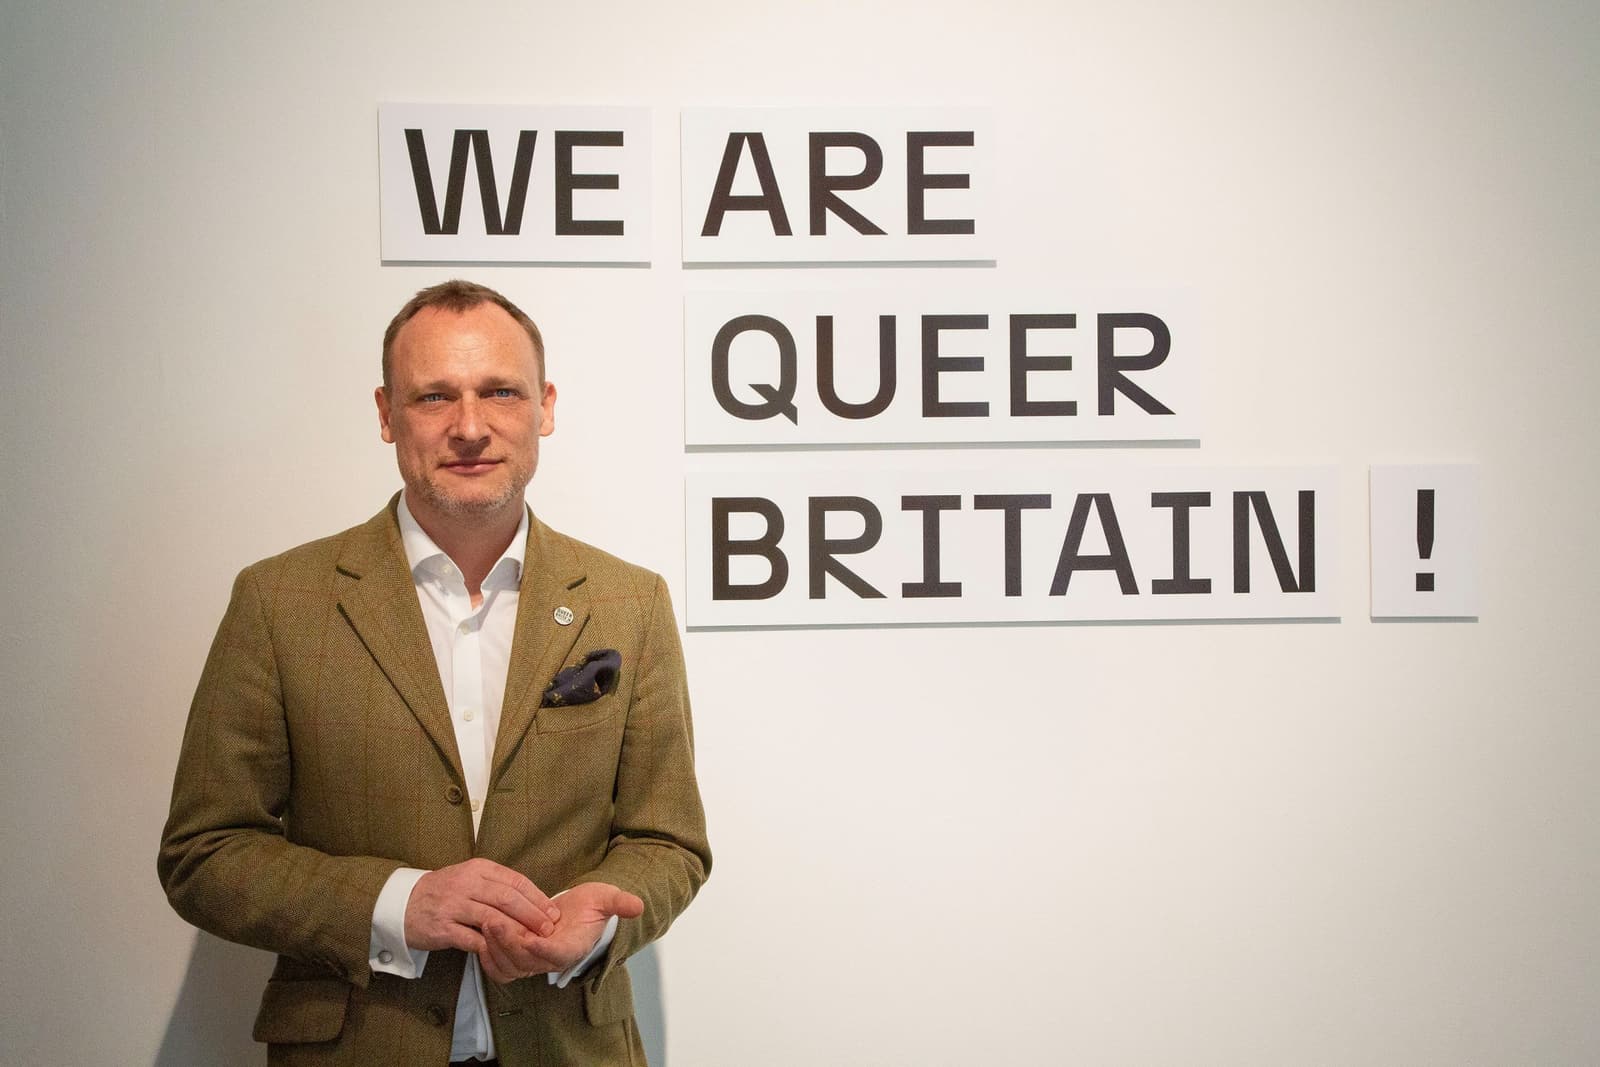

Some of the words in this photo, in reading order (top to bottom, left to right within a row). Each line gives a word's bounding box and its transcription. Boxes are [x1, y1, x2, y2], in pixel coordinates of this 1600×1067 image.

[405, 129, 624, 236] WE
[701, 132, 975, 237] ARE
[712, 313, 1175, 425] QUEER
[712, 491, 1316, 600] BRITAIN
[1415, 489, 1435, 591] !
